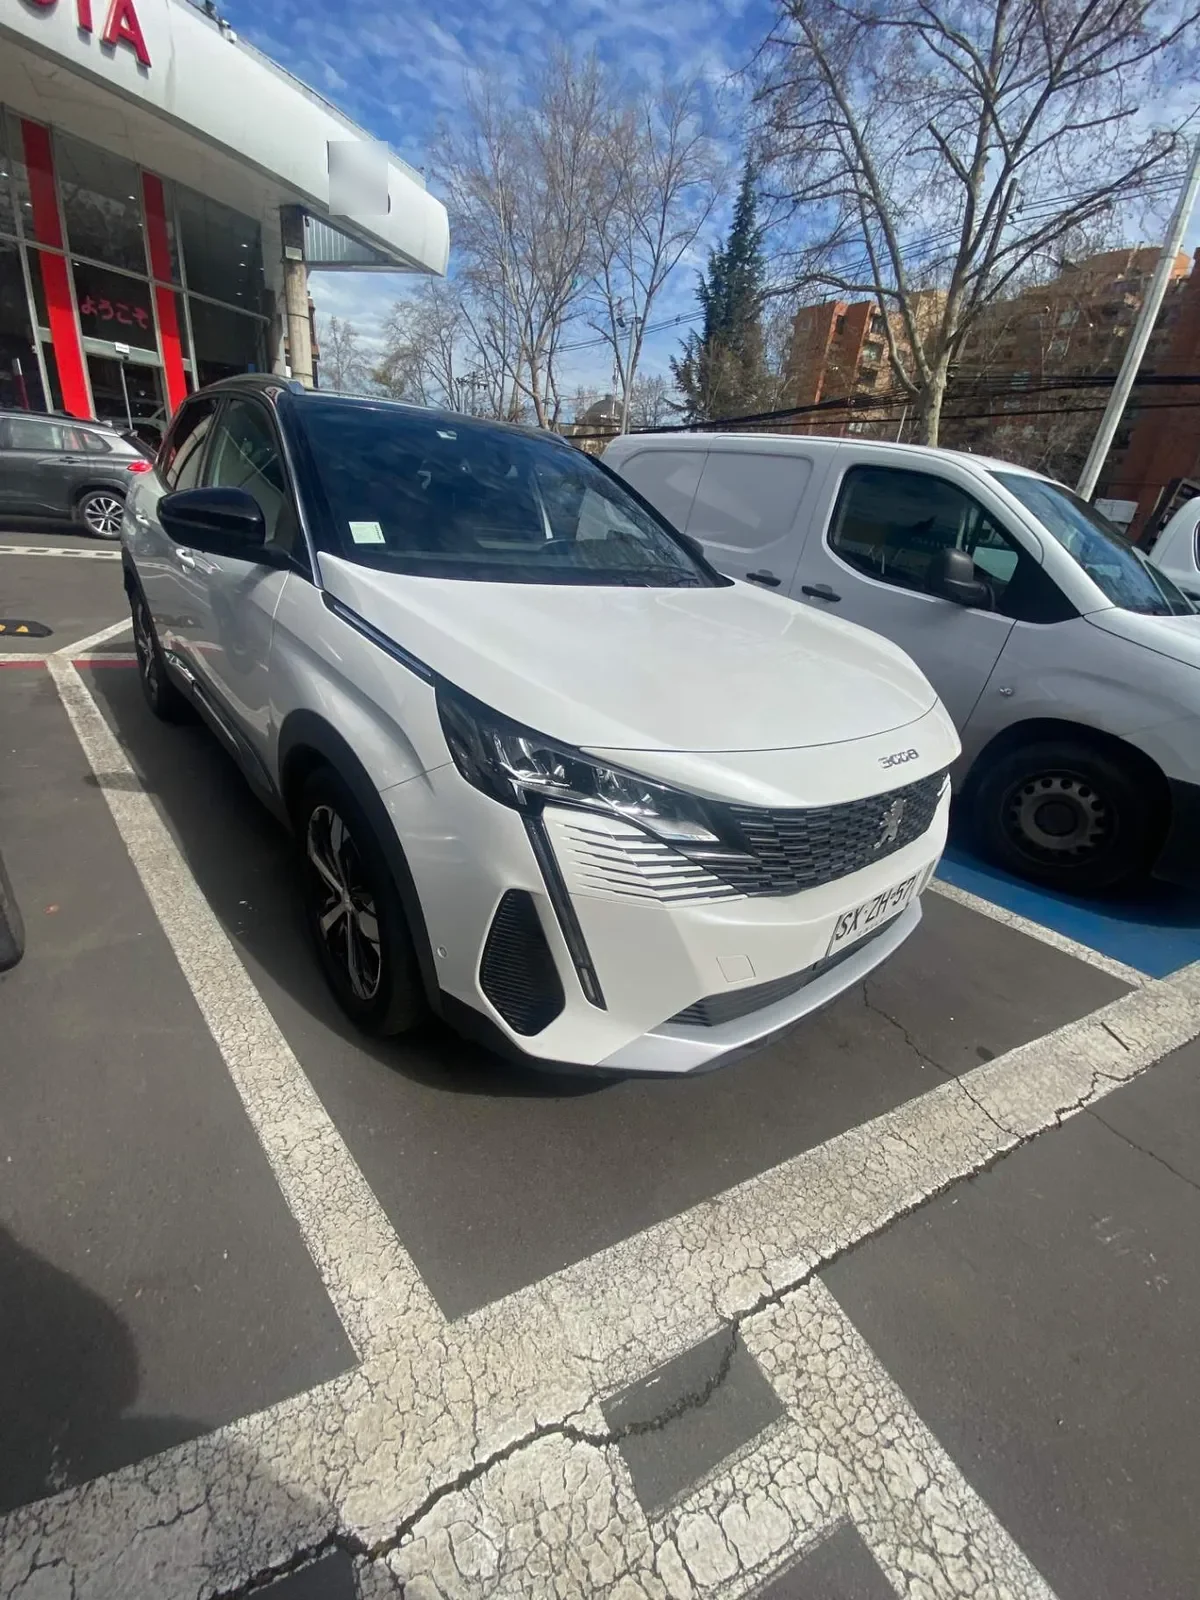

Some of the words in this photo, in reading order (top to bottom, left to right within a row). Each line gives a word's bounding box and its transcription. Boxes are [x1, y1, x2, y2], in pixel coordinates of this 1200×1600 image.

[80, 295, 149, 330] ようこそ
[878, 749, 919, 769] 3008
